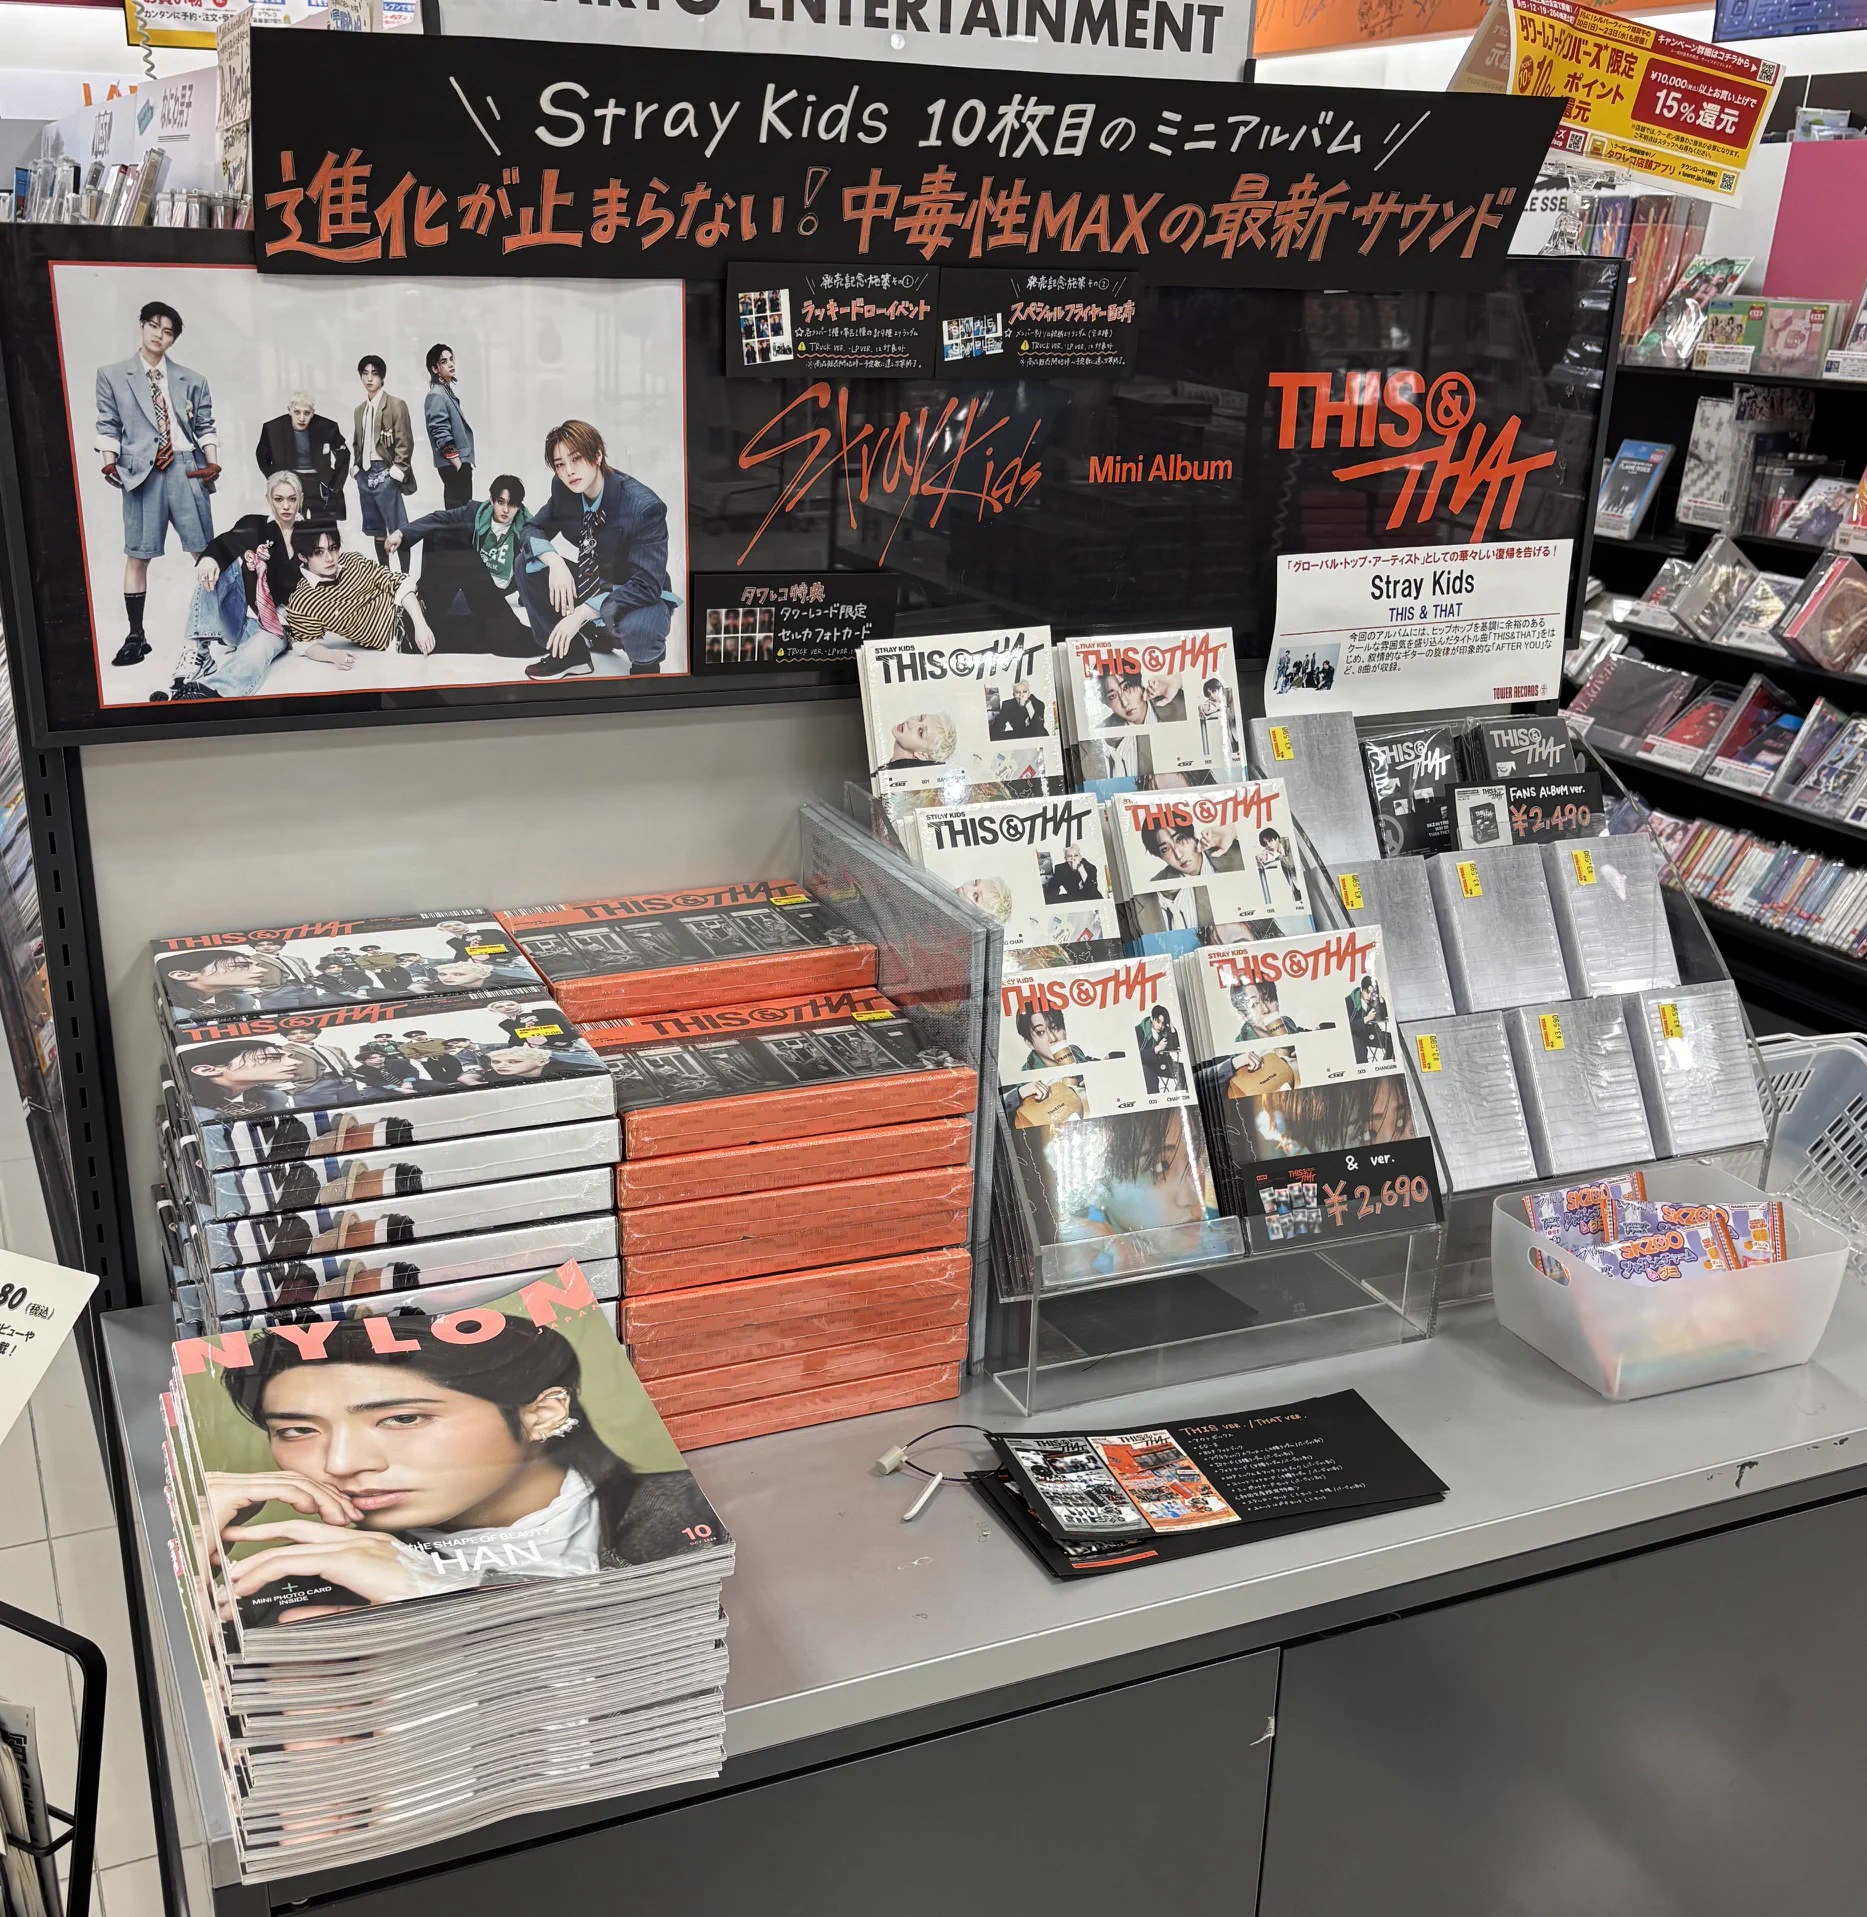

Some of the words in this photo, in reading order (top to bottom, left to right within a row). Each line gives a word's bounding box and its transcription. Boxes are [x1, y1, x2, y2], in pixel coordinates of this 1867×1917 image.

[1563, 72, 1625, 105] ポイント
[535, 82, 740, 158] Stray
[757, 83, 889, 147] Kids
[801, 297, 931, 323] ラッキードローイベント
[1007, 299, 1136, 325] スペシャルフライヤー配布
[1088, 455, 1143, 484] Mini
[1148, 453, 1233, 483] Album
[1331, 414, 1558, 545] THAT
[740, 581, 826, 605] タワレコ特典
[1370, 574, 1424, 601] Stray
[1432, 569, 1475, 596] Kids
[780, 603, 868, 621] タワーレコード限定
[1389, 606, 1415, 622] THIS
[1419, 605, 1428, 620] &
[1433, 602, 1463, 618] THAT
[777, 622, 873, 643] セルカフォトカード
[875, 646, 897, 654] STRAY
[898, 644, 915, 652] KIDS
[1493, 686, 1513, 700] TOWER
[1513, 684, 1539, 698] RECORDS
[1510, 736, 1567, 768] THAT
[1394, 747, 1452, 781] THAT
[1509, 787, 1537, 802] FANS
[1539, 784, 1569, 799] ALBUM
[1569, 785, 1586, 795] ver.
[948, 811, 966, 819] KIDS
[1207, 951, 1230, 959] STRAY
[1231, 949, 1248, 957] KIDS
[1344, 1154, 1360, 1171] &
[1370, 1153, 1395, 1167] ver.
[1620, 1231, 1685, 1260] SKZOO
[176, 1257, 599, 1376] NYLON
[1179, 1422, 1218, 1437] THIS
[433, 1536, 478, 1549] SHAPE
[479, 1534, 498, 1544] OF
[499, 1526, 552, 1541] BEAUTY
[681, 1524, 712, 1540] 10
[430, 1540, 545, 1575] HAN
[252, 1595, 273, 1606] MINI
[273, 1591, 306, 1603] PHOTO
[305, 1586, 333, 1596] CARD
[278, 1595, 309, 1606] INSIDE
